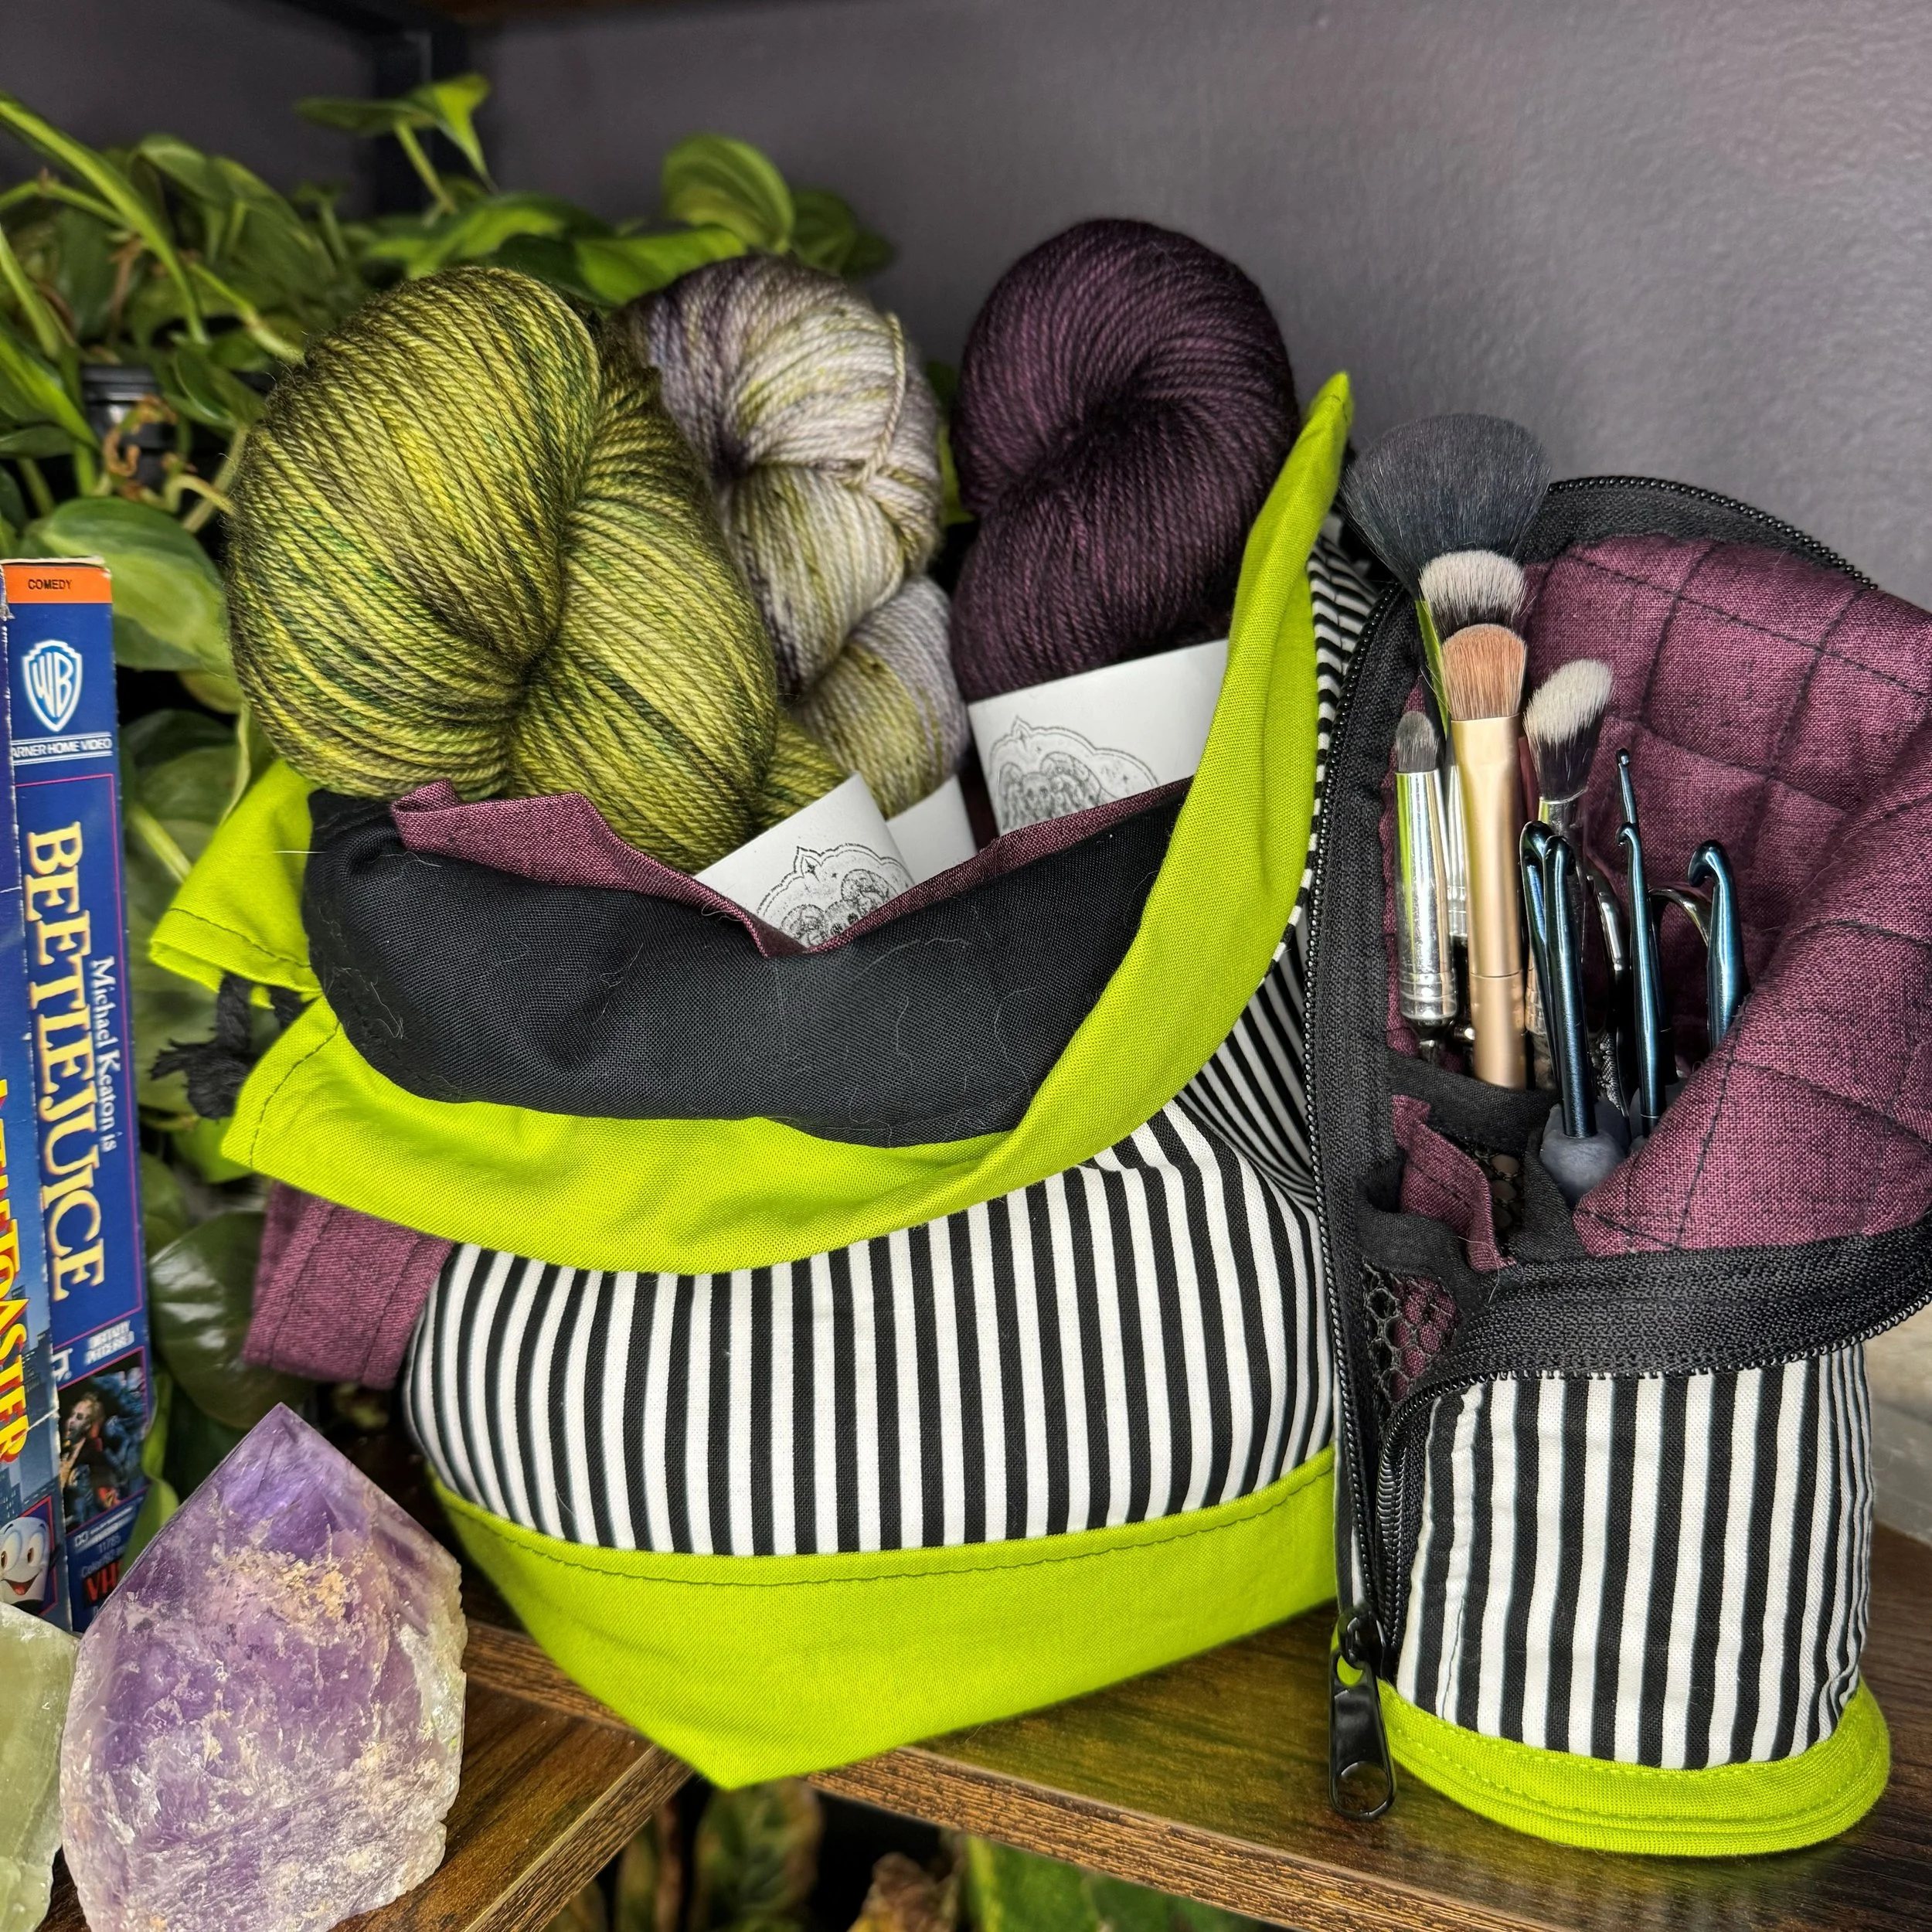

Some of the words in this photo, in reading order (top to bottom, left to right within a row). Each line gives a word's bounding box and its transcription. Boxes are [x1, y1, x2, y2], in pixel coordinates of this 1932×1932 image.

[28, 579, 72, 590] COMEDY
[11, 743, 46, 757] ARNER
[46, 741, 80, 754] HOME
[80, 737, 113, 750] VIDEO
[90, 955, 119, 1048] Michael
[25, 821, 105, 1302] BEETLEJUICE
[97, 1049, 121, 1132] Keaton
[99, 1131, 124, 1153] is
